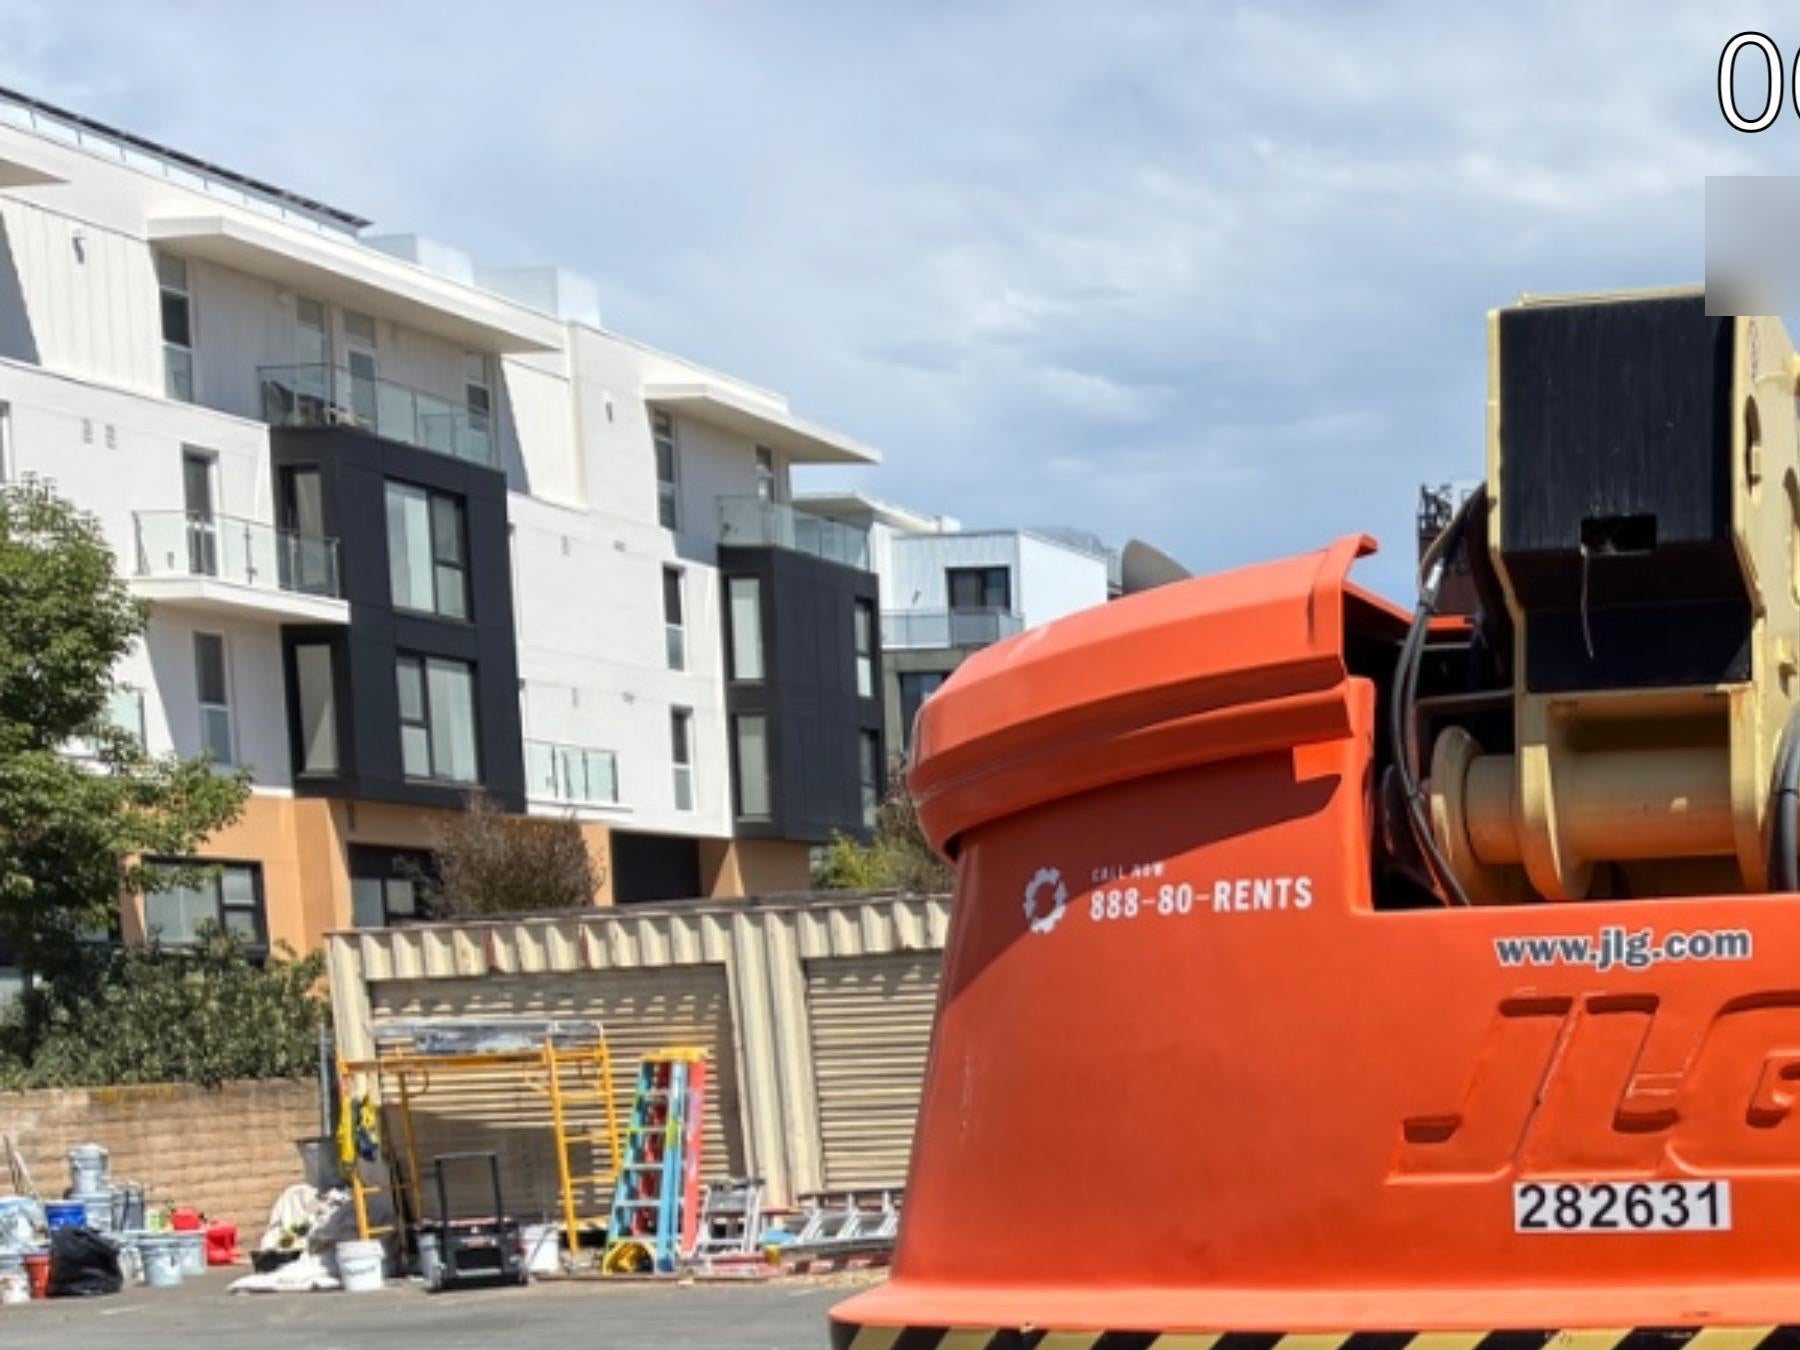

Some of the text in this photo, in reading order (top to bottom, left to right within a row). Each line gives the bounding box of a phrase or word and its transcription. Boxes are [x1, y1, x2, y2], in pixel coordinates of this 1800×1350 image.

[1090, 876, 1313, 921] 888-80-RENTS
[1496, 927, 1752, 971] www.jlg.com
[1519, 1183, 1721, 1228] 282631
